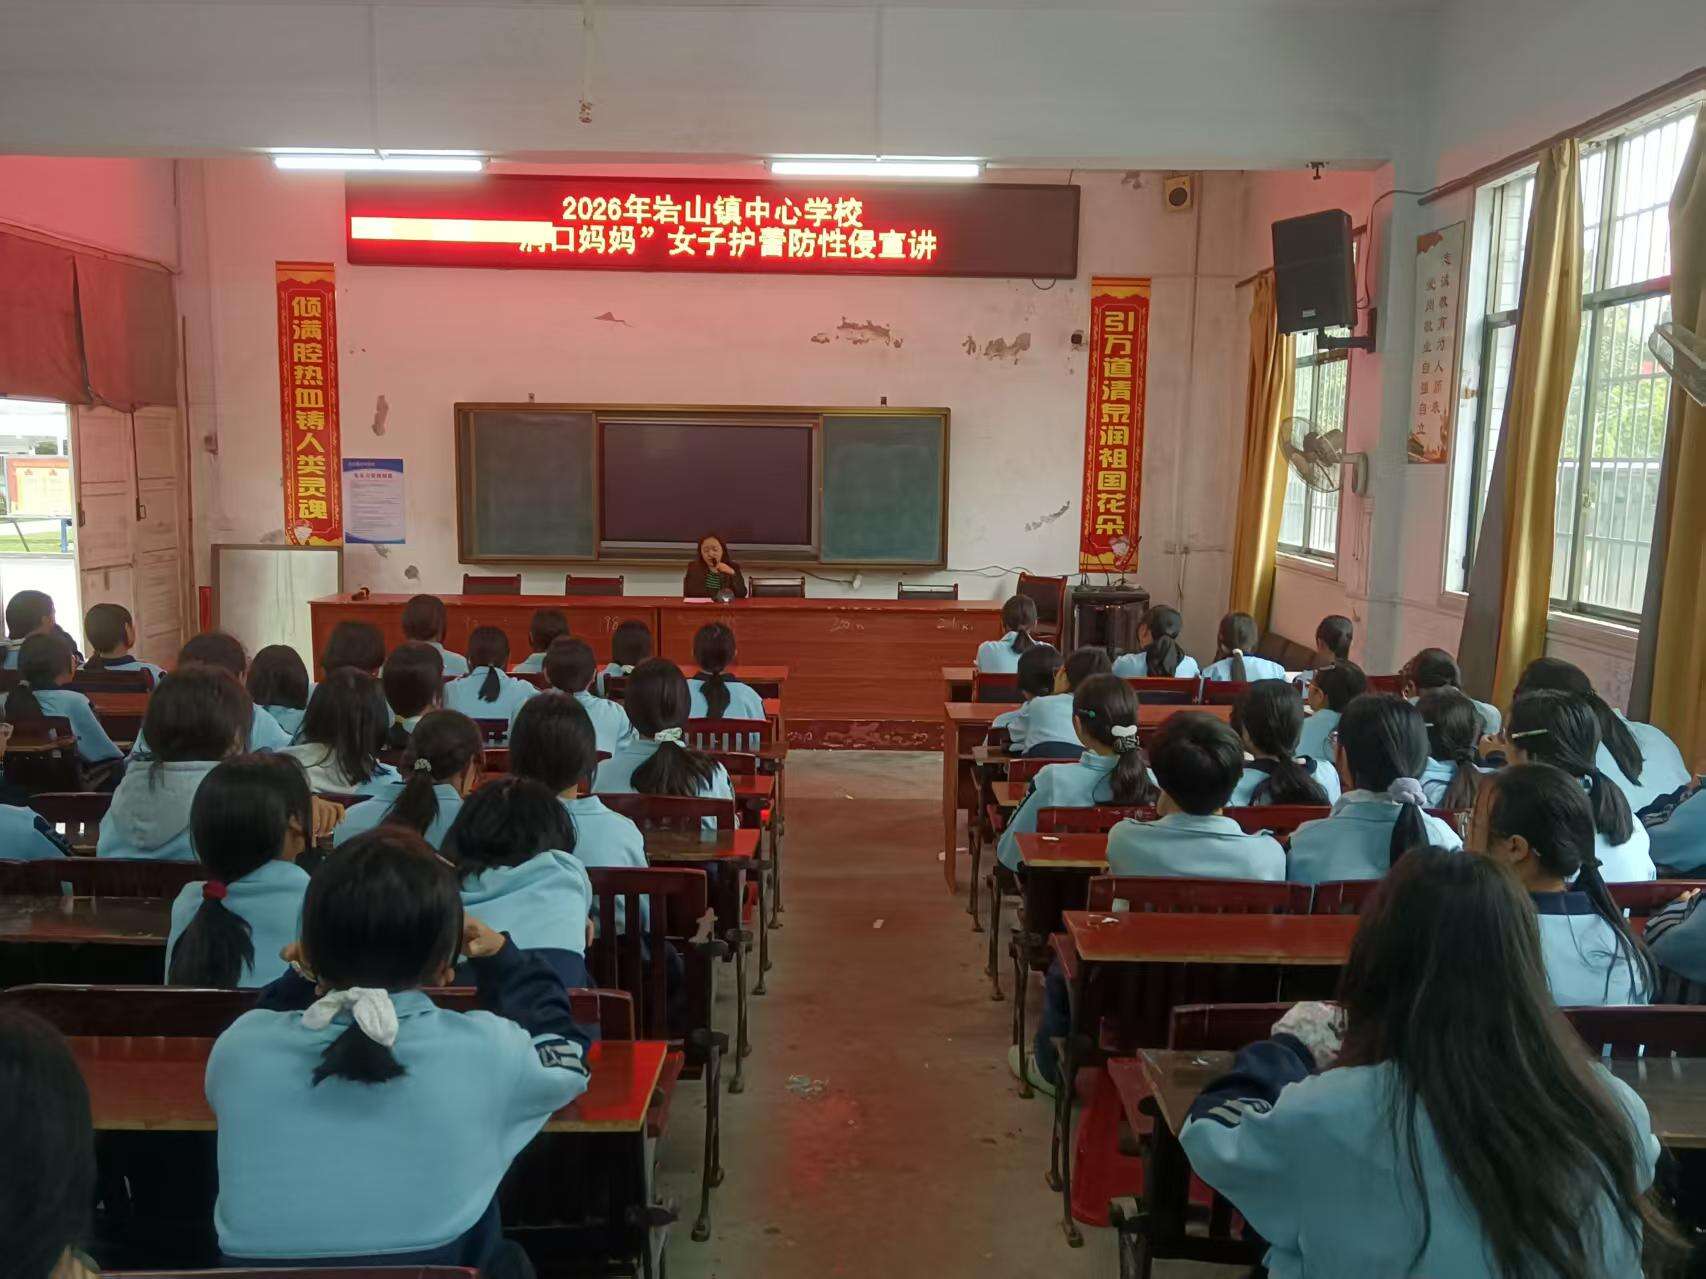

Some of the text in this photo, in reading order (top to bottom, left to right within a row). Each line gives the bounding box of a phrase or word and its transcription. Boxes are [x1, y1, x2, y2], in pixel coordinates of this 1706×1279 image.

[562, 193, 864, 227] 2026年岩山镇中心学校
[291, 296, 328, 520] 倾满腔热血铸人类灵魂
[1095, 311, 1134, 535] 引万道清泉润祖国花朵
